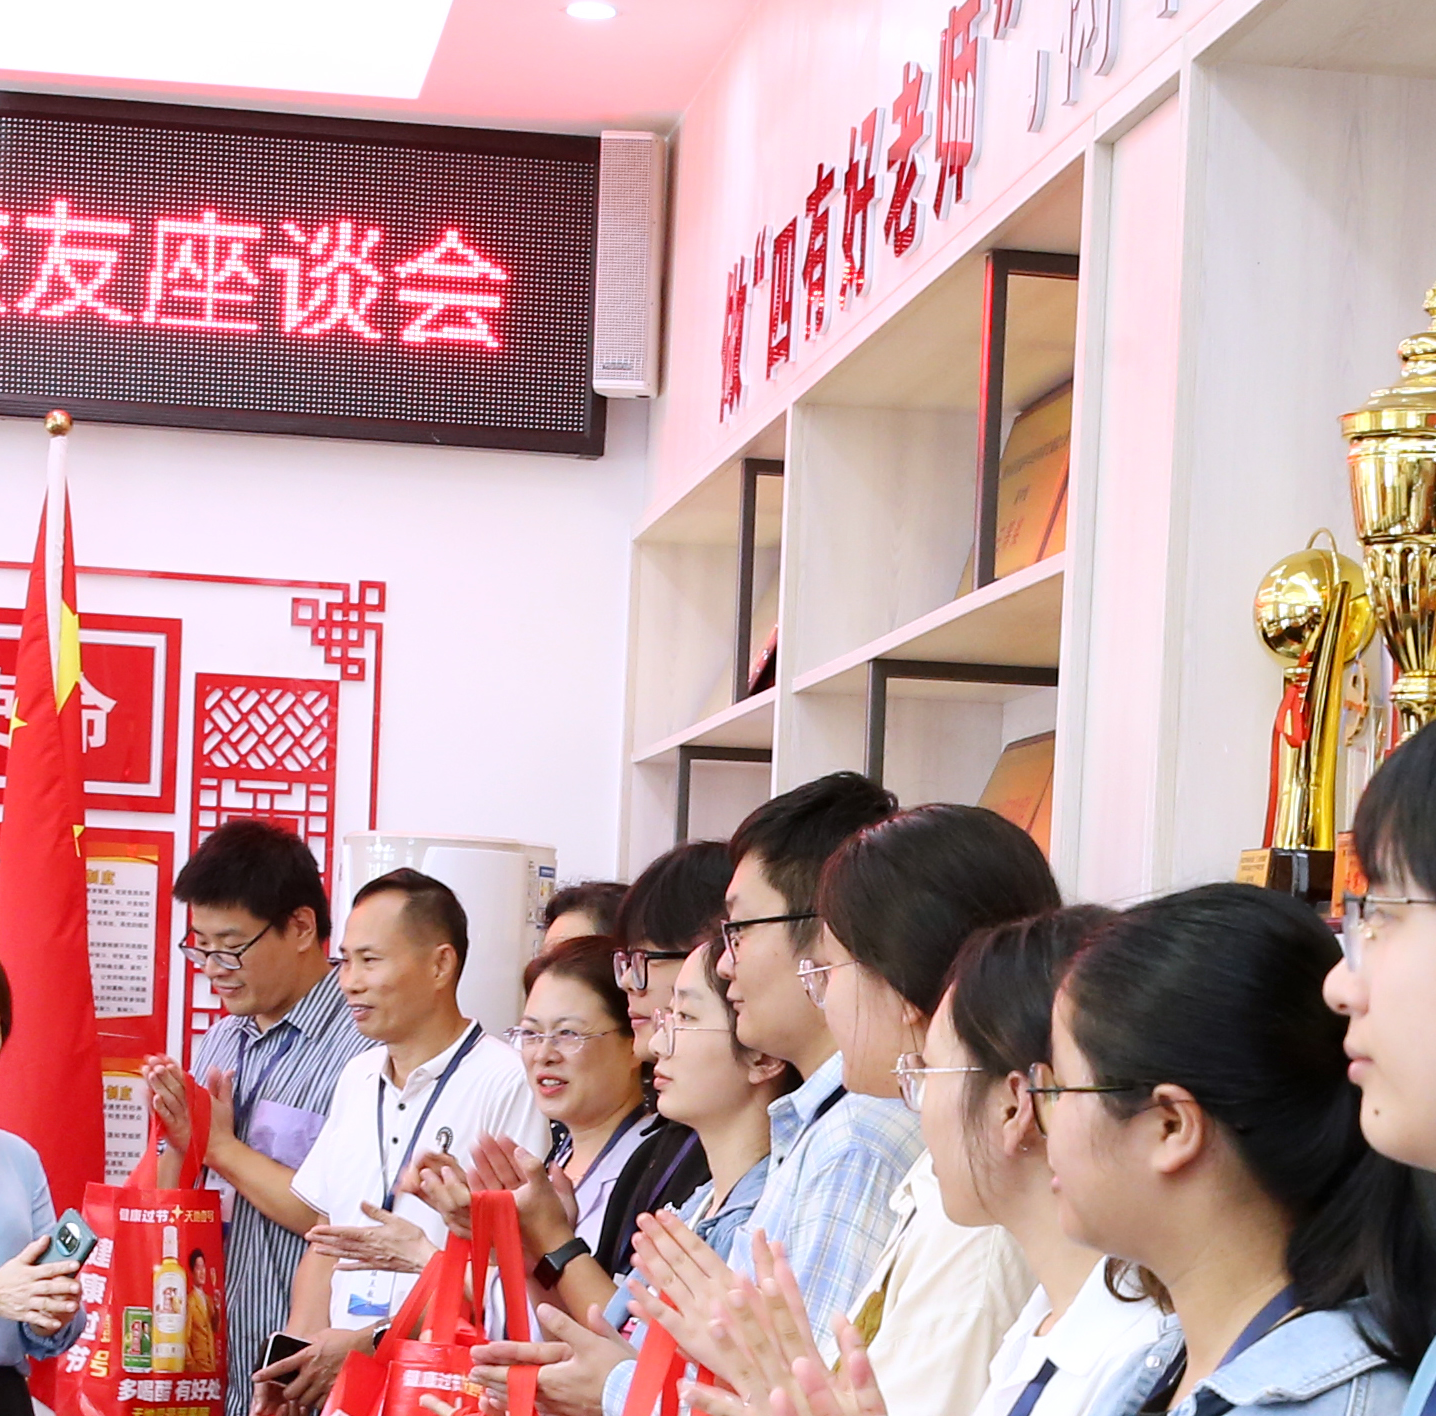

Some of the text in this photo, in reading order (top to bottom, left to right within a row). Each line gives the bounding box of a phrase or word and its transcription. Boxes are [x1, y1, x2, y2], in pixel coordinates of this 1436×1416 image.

[119, 1207, 168, 1223] 健康过节
[117, 1378, 221, 1402] 多喝醋 有好处
